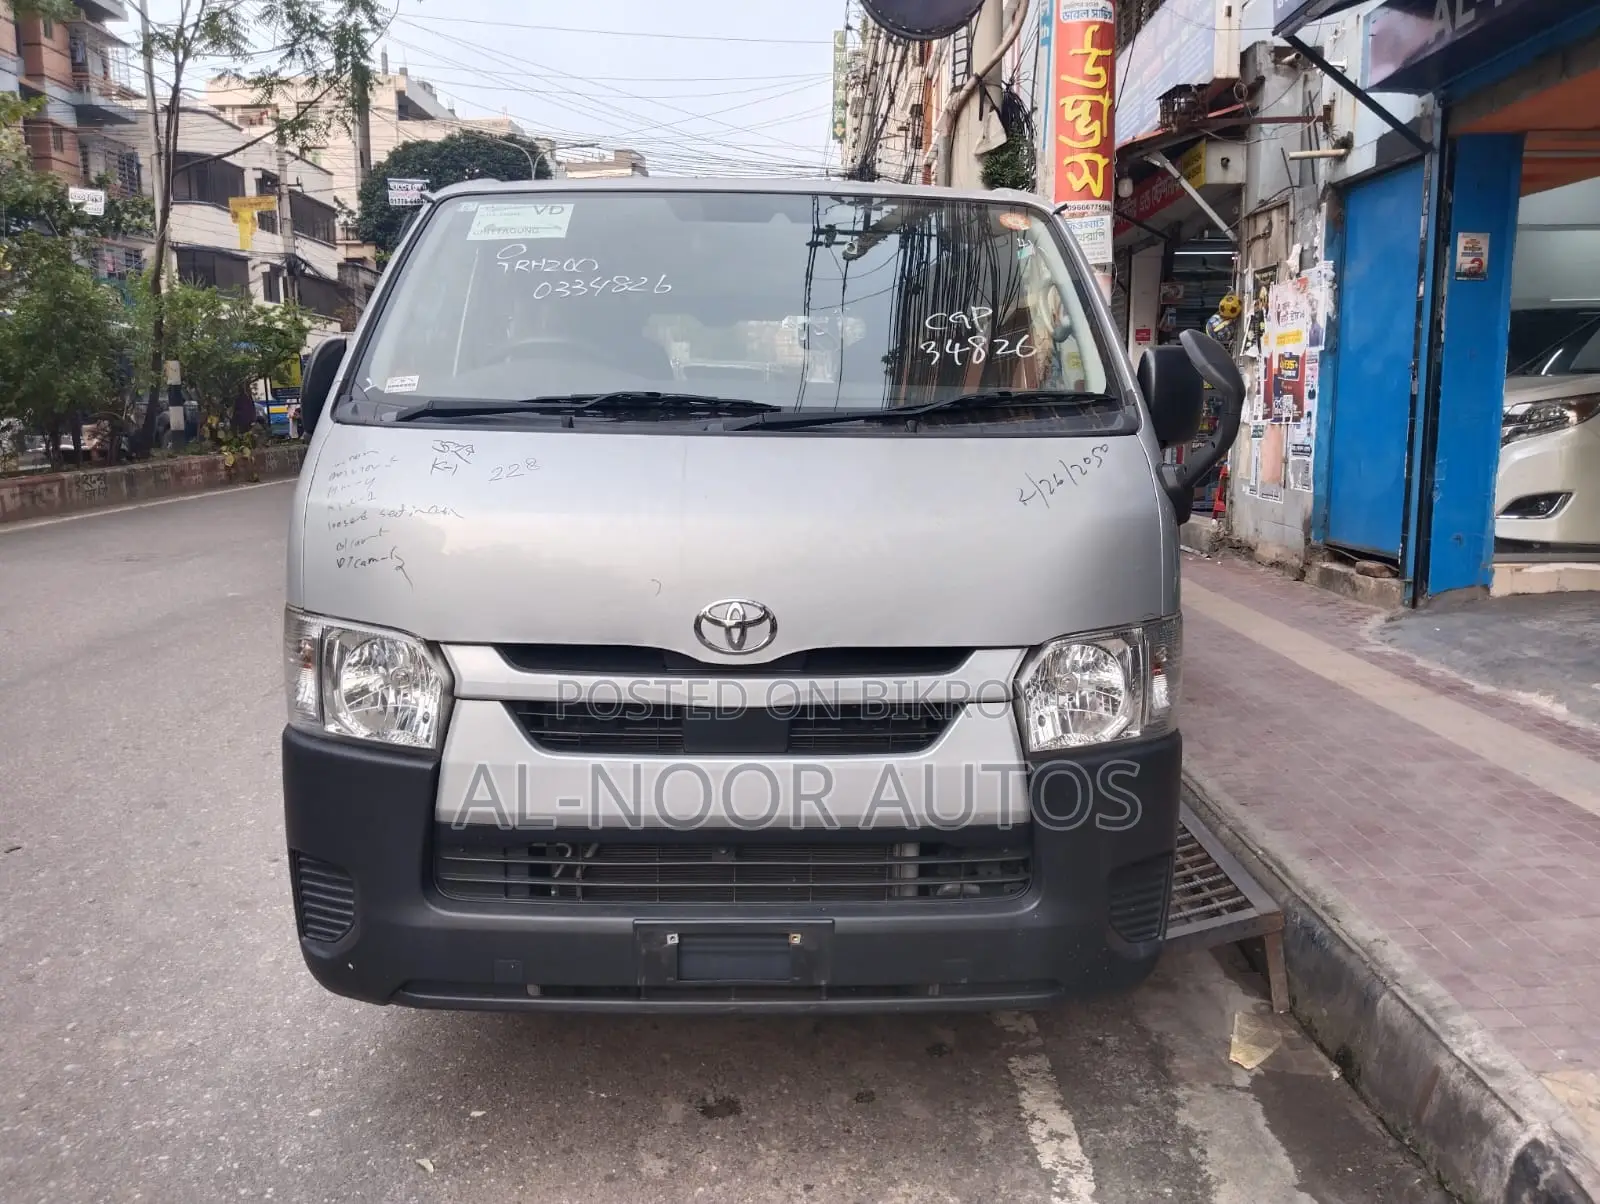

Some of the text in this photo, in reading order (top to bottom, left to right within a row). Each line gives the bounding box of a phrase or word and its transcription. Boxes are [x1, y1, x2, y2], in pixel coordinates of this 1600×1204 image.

[533, 204, 565, 216] VD
[533, 273, 673, 300] 0334826
[919, 333, 1038, 367] 34826
